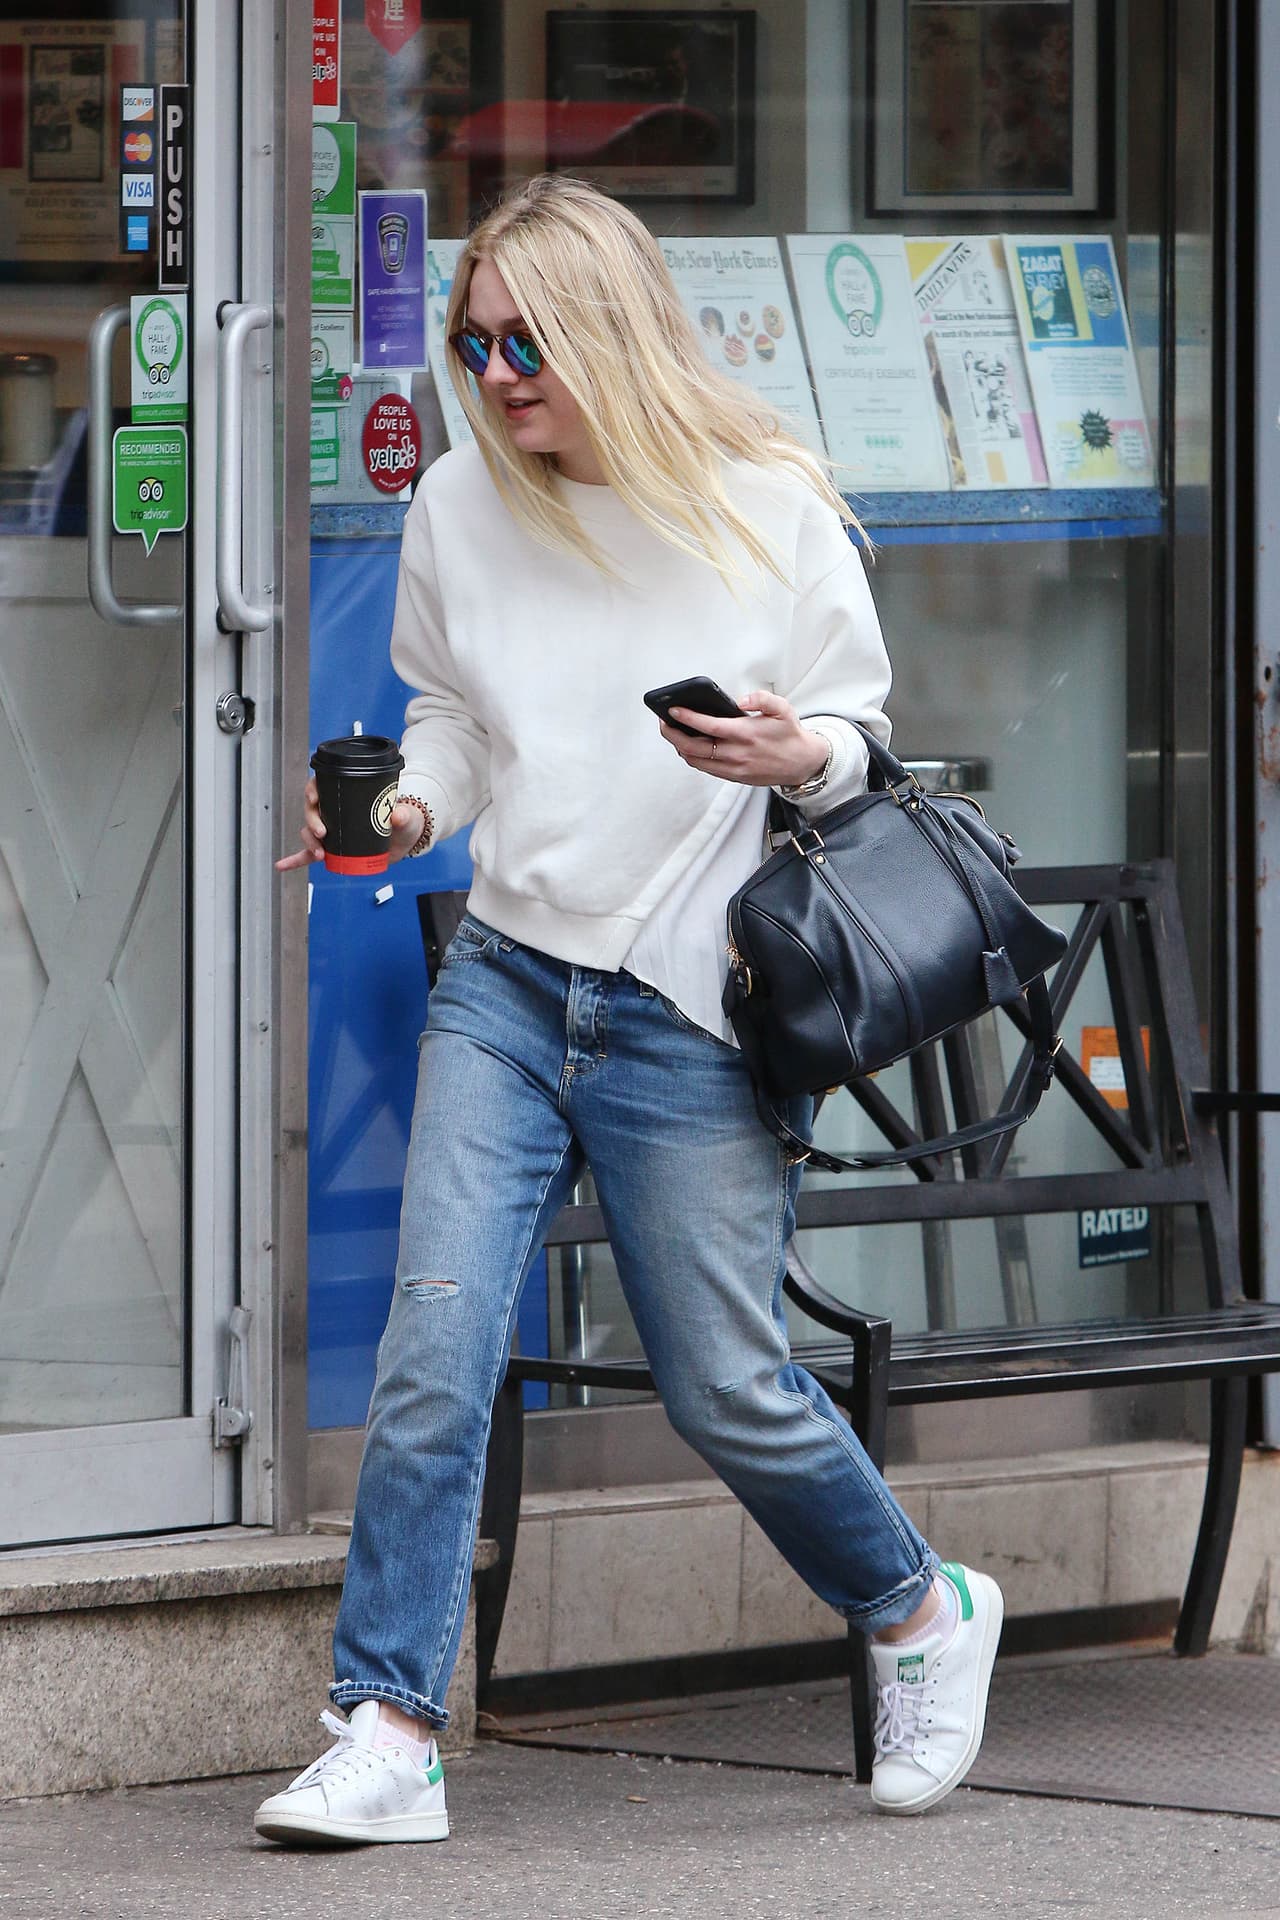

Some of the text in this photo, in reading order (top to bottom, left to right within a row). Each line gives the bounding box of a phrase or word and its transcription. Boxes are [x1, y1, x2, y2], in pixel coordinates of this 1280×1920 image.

[312, 18, 335, 27] EOPLE
[325, 33, 336, 42] US
[315, 47, 326, 56] ON
[123, 96, 152, 106] DISCOVER
[125, 181, 152, 198] VISA
[166, 104, 184, 267] PUSH
[664, 249, 779, 274] The New York Times
[1020, 255, 1062, 272] ZAGAT
[1024, 273, 1065, 290] SURVEY
[148, 334, 164, 343] HALL
[151, 345, 168, 354] FAME
[142, 389, 176, 401] tripadvisor
[379, 406, 407, 416] PEOPLE
[374, 418, 411, 430] LOVE US
[120, 444, 181, 455] RECOMMENDED
[312, 443, 334, 454] INNER
[369, 444, 401, 473] yelp
[130, 508, 171, 522] tripadvisor
[1081, 1207, 1148, 1238] RATED
